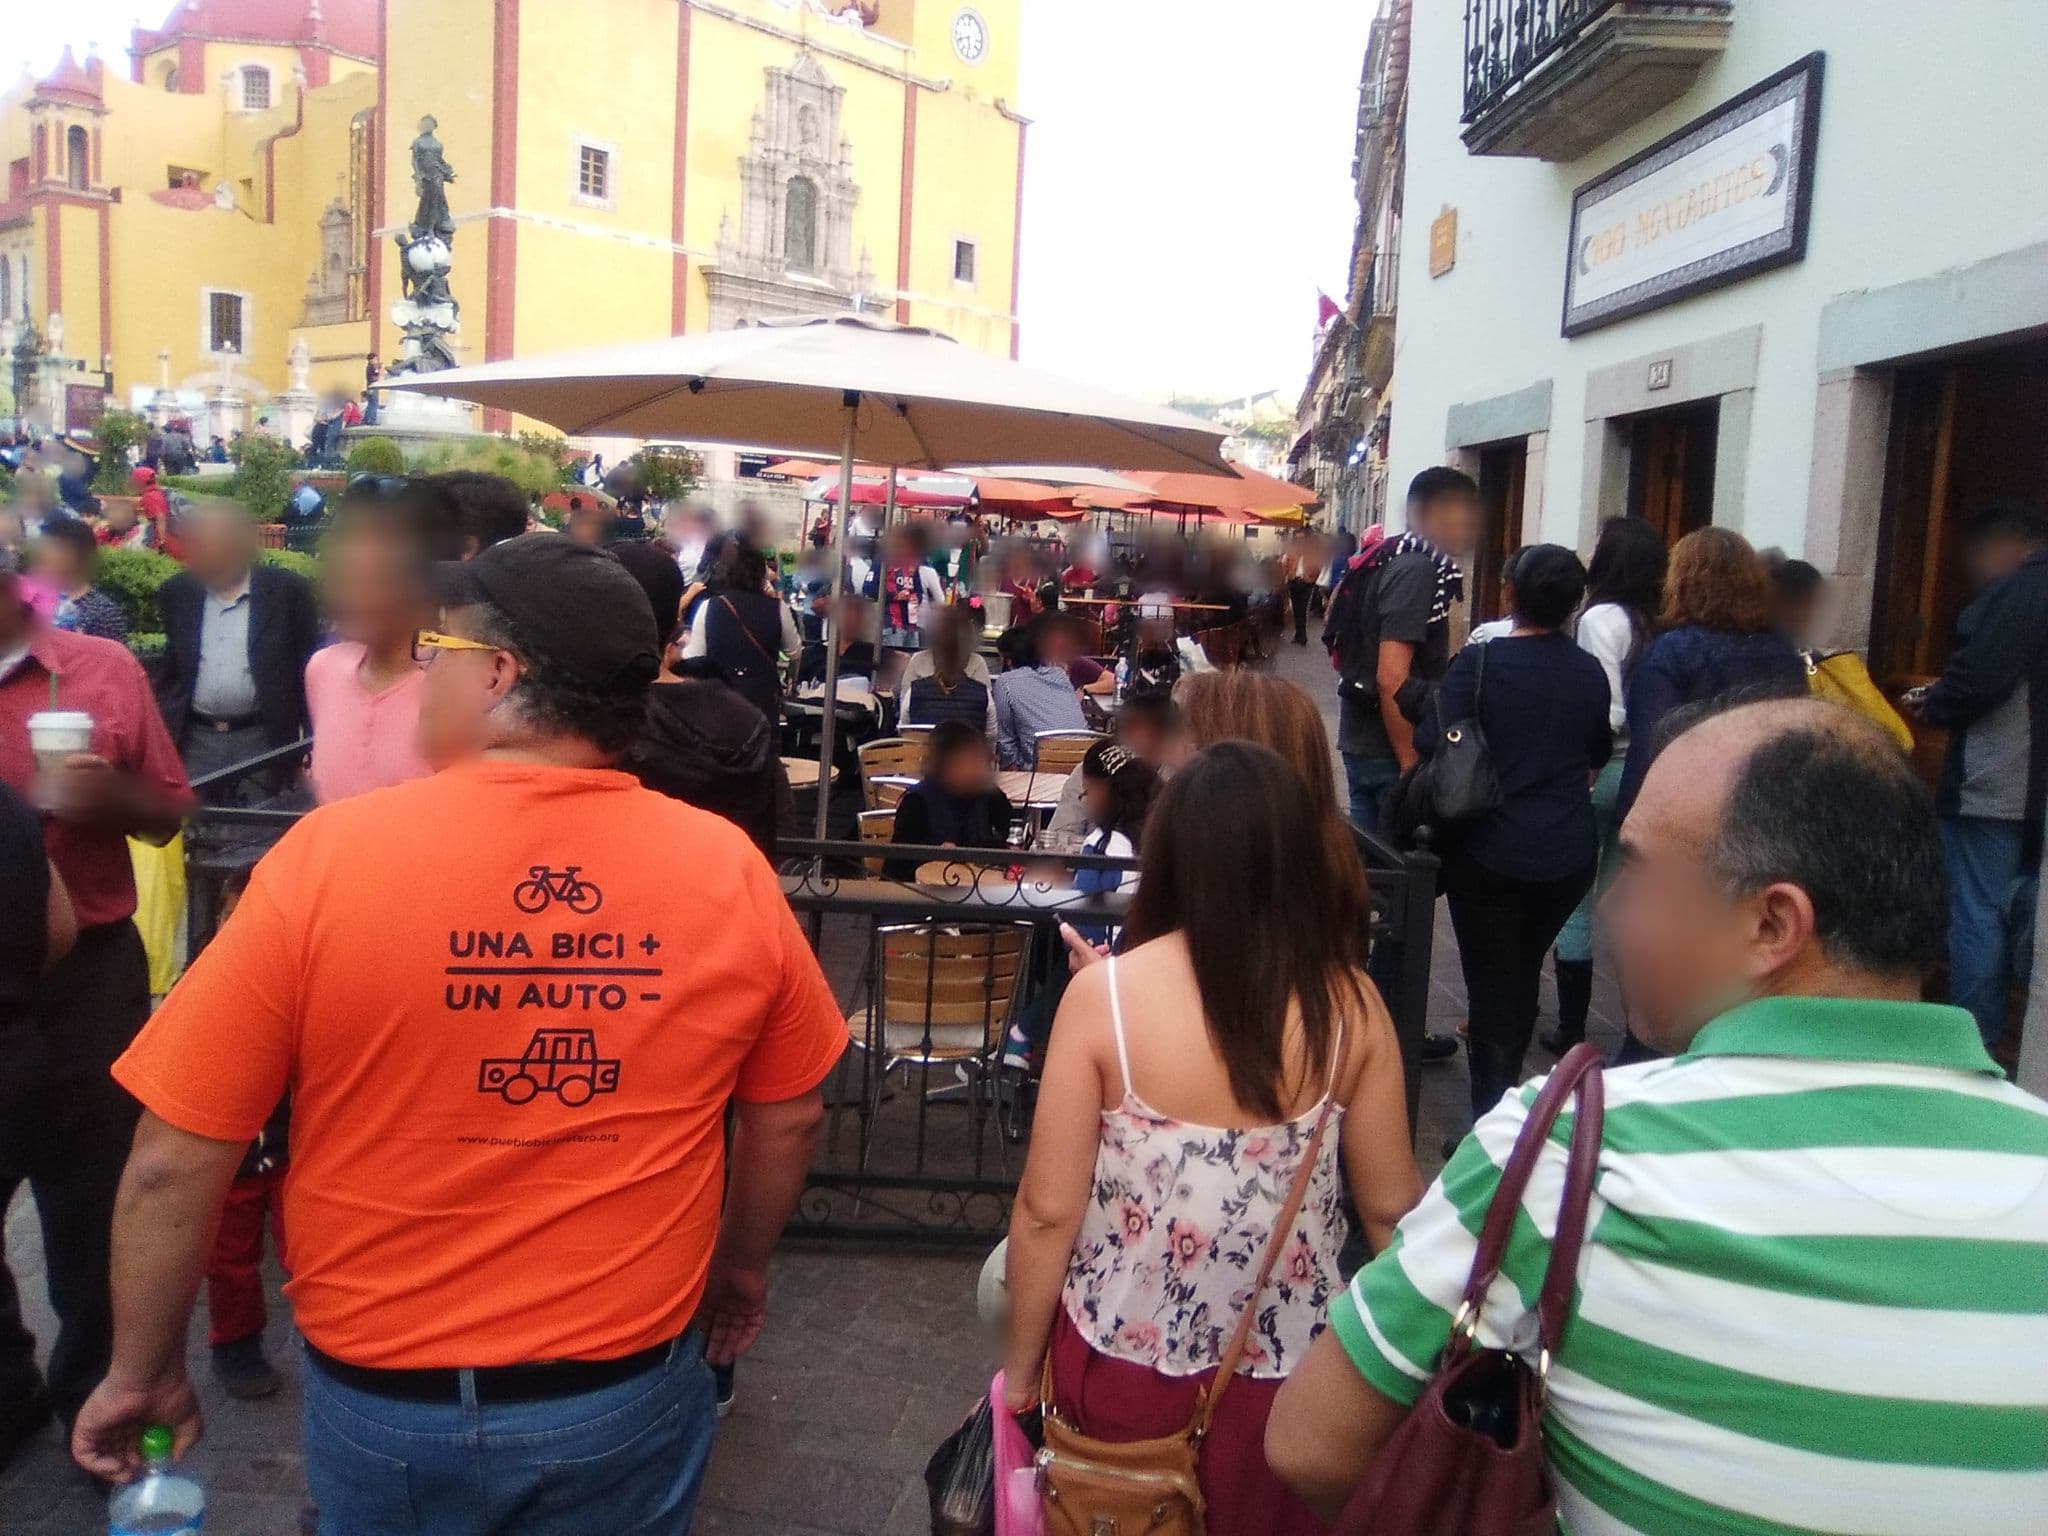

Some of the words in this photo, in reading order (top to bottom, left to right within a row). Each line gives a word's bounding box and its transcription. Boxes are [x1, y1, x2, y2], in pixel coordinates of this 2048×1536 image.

[451, 931, 533, 958] UNA
[552, 933, 624, 959] BICI
[445, 984, 501, 1011] UN
[517, 982, 627, 1011] AUTO
